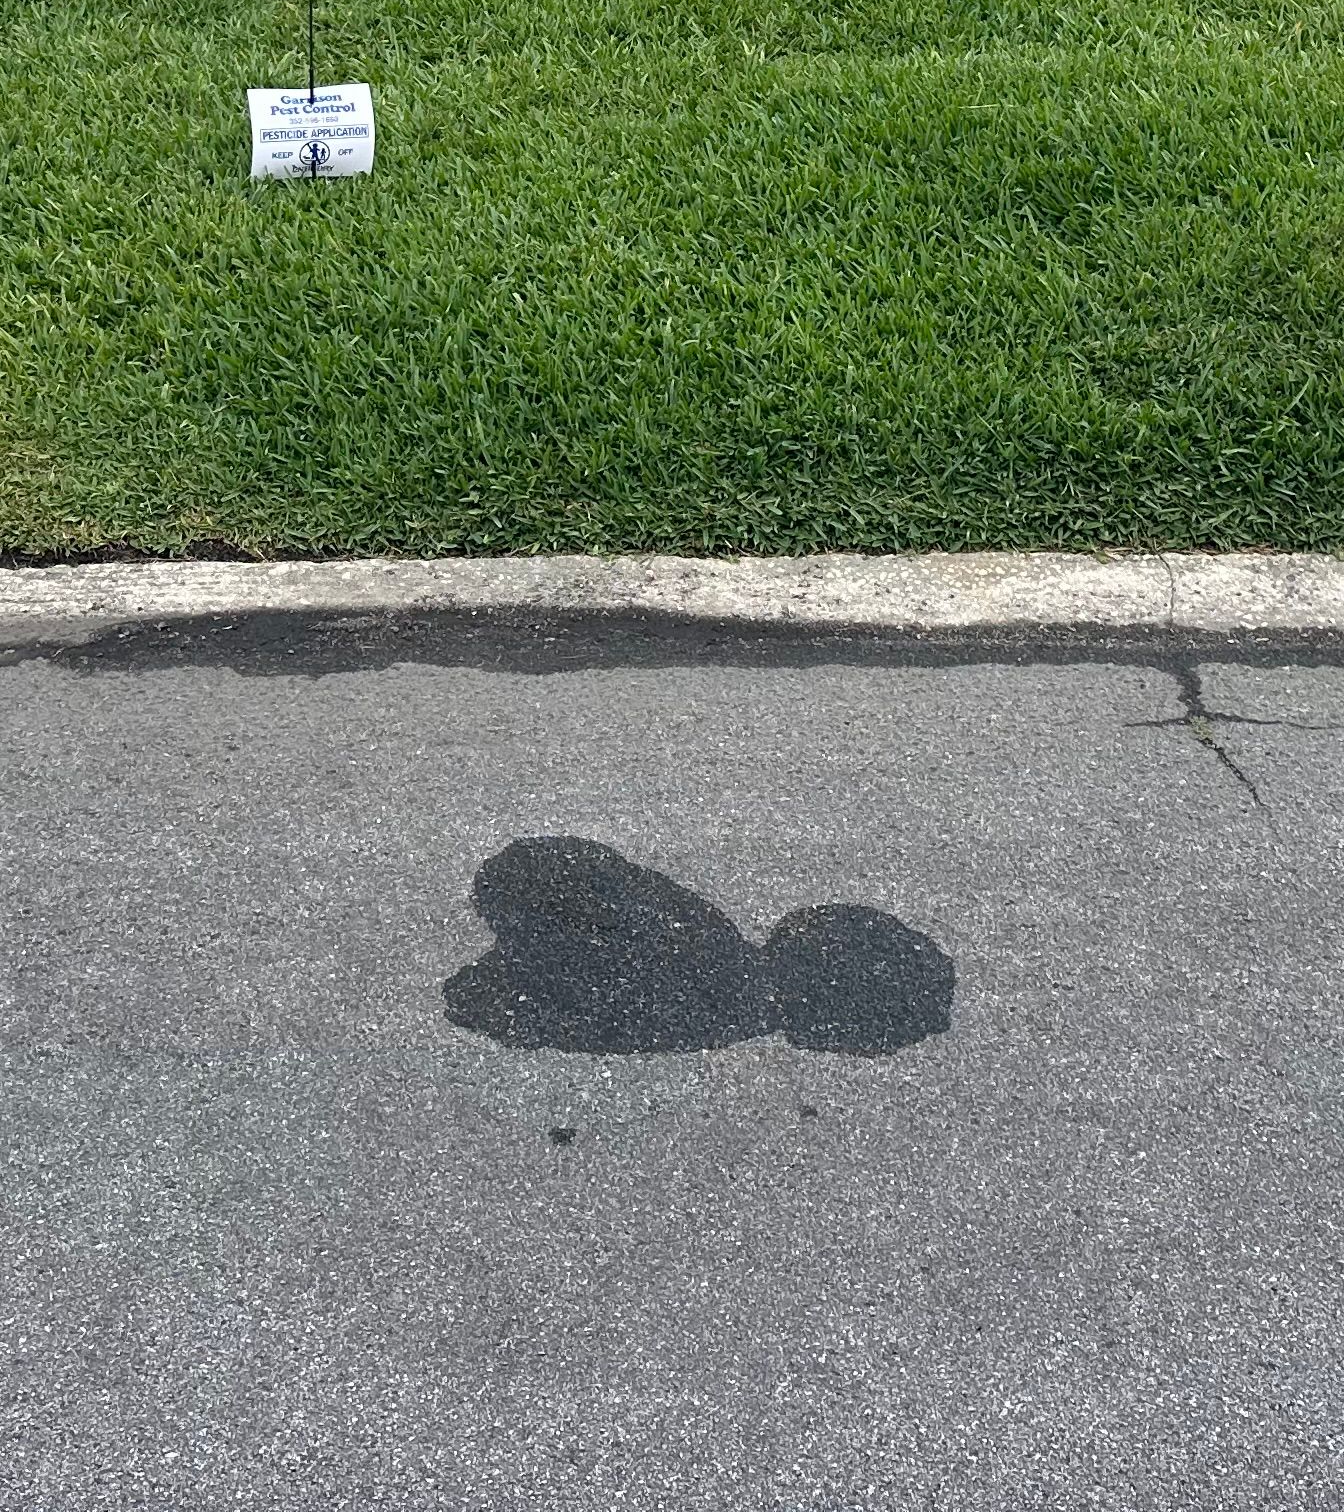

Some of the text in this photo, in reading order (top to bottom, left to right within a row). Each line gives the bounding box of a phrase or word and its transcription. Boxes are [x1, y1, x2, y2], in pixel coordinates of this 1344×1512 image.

[270, 102, 356, 116] Pest Control
[262, 126, 367, 140] PESTICIDE APPLICATION
[337, 148, 354, 156] OFF
